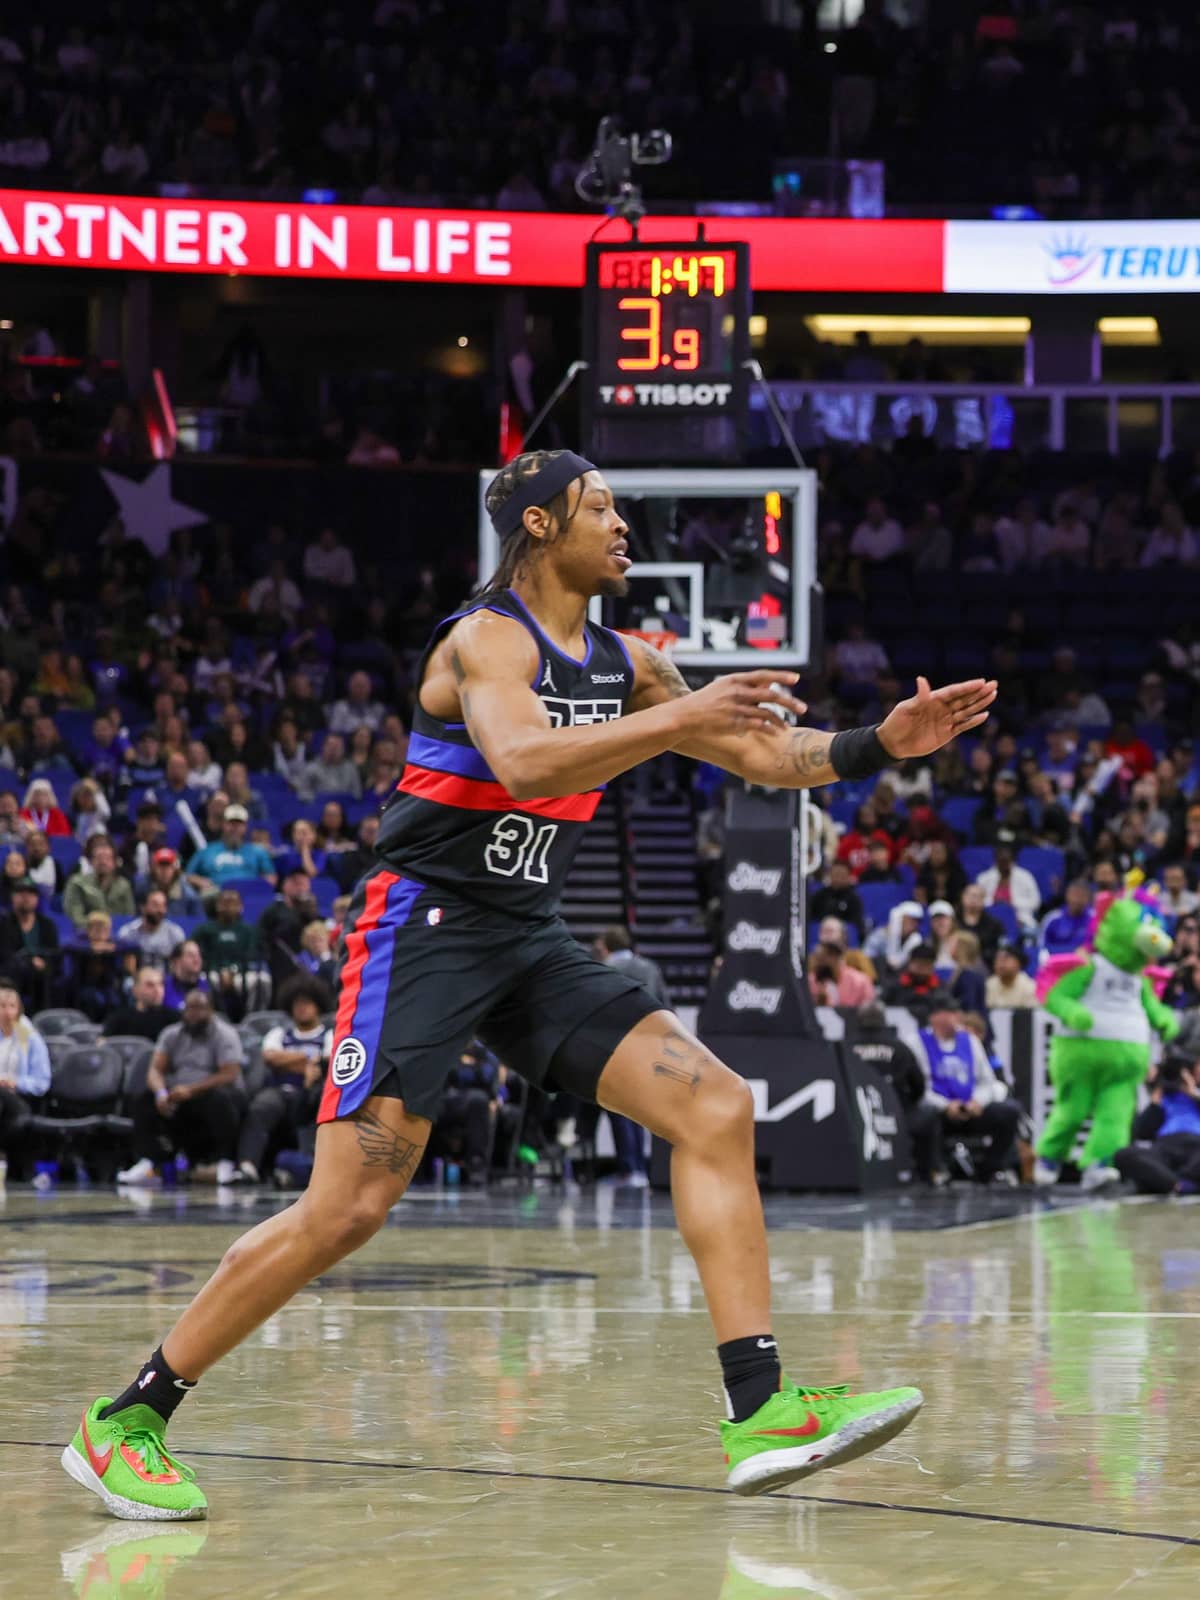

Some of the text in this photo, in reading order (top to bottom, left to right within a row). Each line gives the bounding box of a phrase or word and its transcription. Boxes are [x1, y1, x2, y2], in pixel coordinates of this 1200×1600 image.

[275, 214, 347, 269] IN
[377, 217, 511, 275] LIFE
[652, 256, 724, 297] 1:47
[618, 299, 699, 370] 3.9
[636, 384, 732, 405] TISSOT
[484, 813, 558, 883] 31
